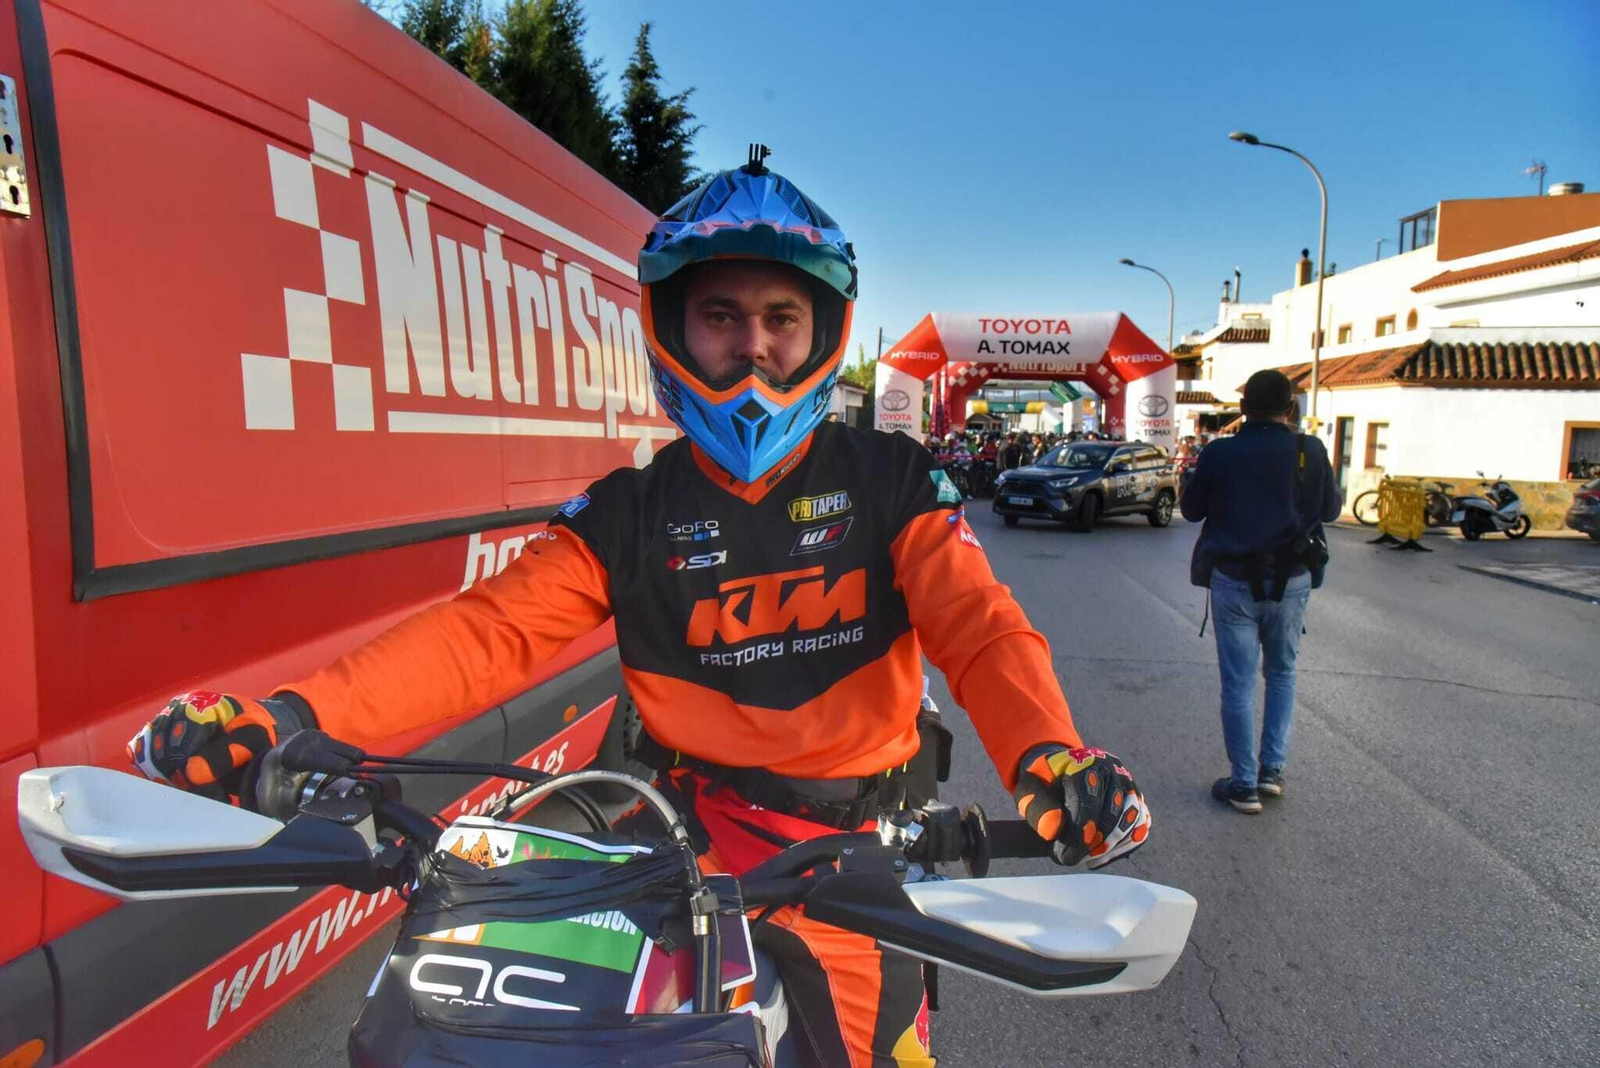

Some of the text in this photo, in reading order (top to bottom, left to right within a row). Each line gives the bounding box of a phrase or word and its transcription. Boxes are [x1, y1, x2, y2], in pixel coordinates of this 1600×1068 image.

[978, 318, 1072, 335] TOYOTA
[977, 340, 1071, 355] A. TOMAX
[890, 351, 940, 360] HYBRID
[1111, 354, 1164, 363] HYBRID
[878, 413, 912, 421] TOYOTA
[1144, 429, 1171, 437] TOMAX
[686, 565, 867, 646] KTM
[701, 626, 864, 667] FACTORY RACING
